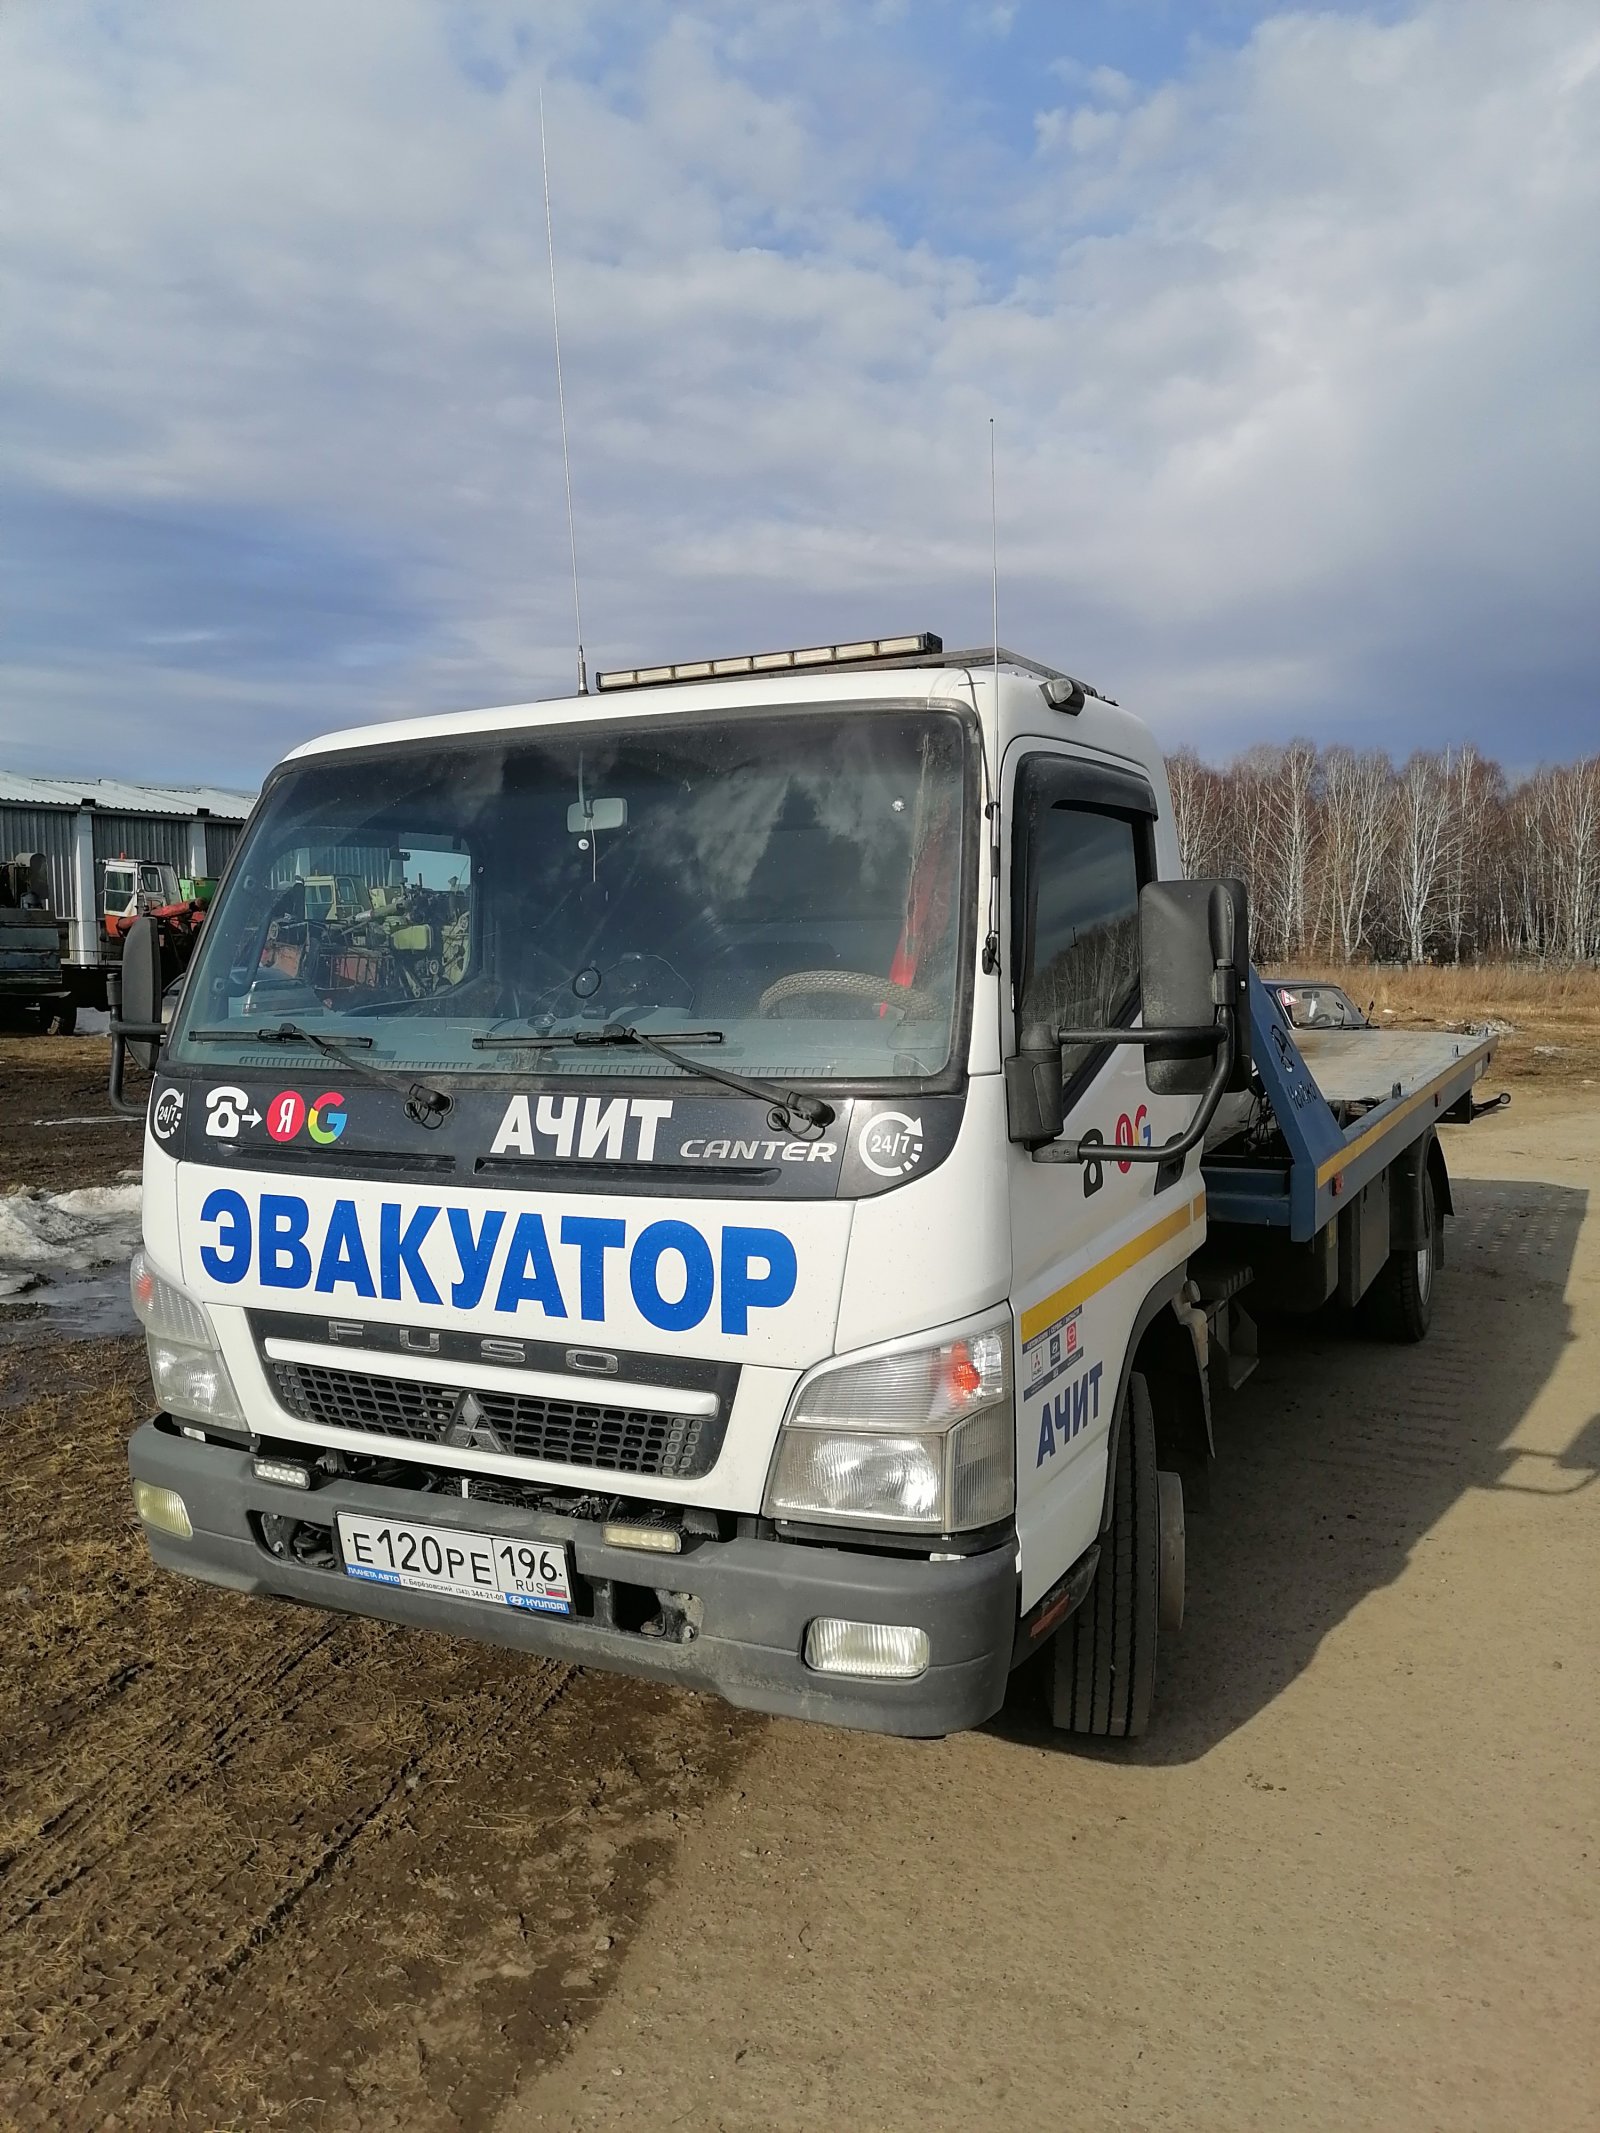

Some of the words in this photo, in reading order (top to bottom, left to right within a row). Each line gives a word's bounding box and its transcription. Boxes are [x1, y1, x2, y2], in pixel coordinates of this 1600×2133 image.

[158, 1104, 176, 1124] 24/7
[307, 1091, 348, 1144] G
[490, 1094, 672, 1162] АЧИТ
[679, 1138, 838, 1163] CANTER
[871, 1132, 910, 1157] 24/7
[199, 1188, 798, 1336] ЭВАКУАТОР
[328, 1320, 619, 1374] FUSO
[1036, 1361, 1103, 1468] АЧИТ
[378, 1573, 400, 1583] АВТО
[500, 1545, 558, 1582] 196
[515, 1579, 545, 1595] RUS
[525, 1597, 567, 1611] HYUNDAI
